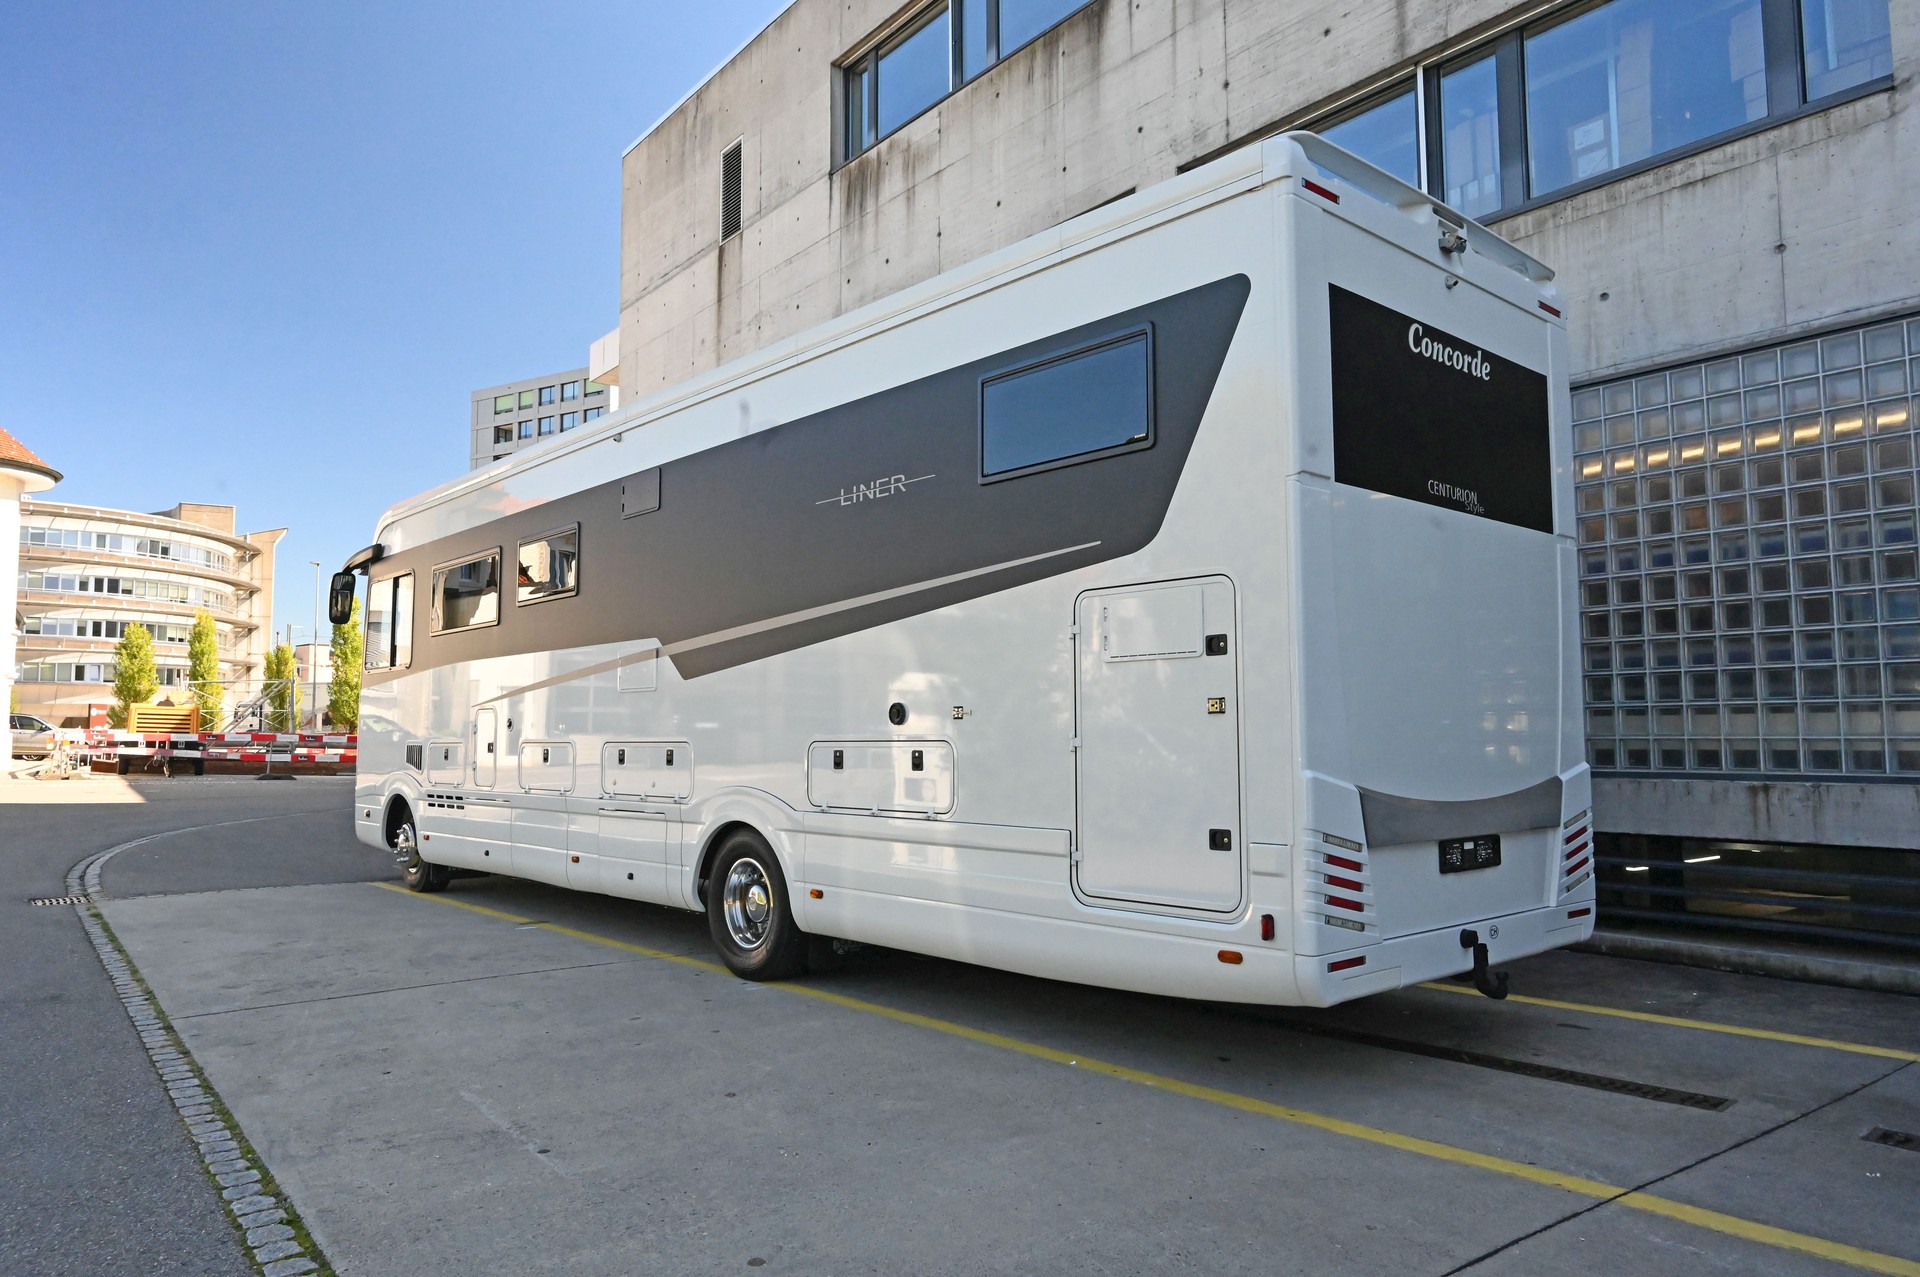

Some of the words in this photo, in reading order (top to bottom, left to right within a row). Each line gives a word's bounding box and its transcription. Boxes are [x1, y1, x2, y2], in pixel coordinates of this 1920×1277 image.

[1408, 323, 1490, 380] Concorde
[840, 474, 906, 506] LINER
[1428, 480, 1477, 504] CENTURION
[1465, 501, 1485, 514] Style
